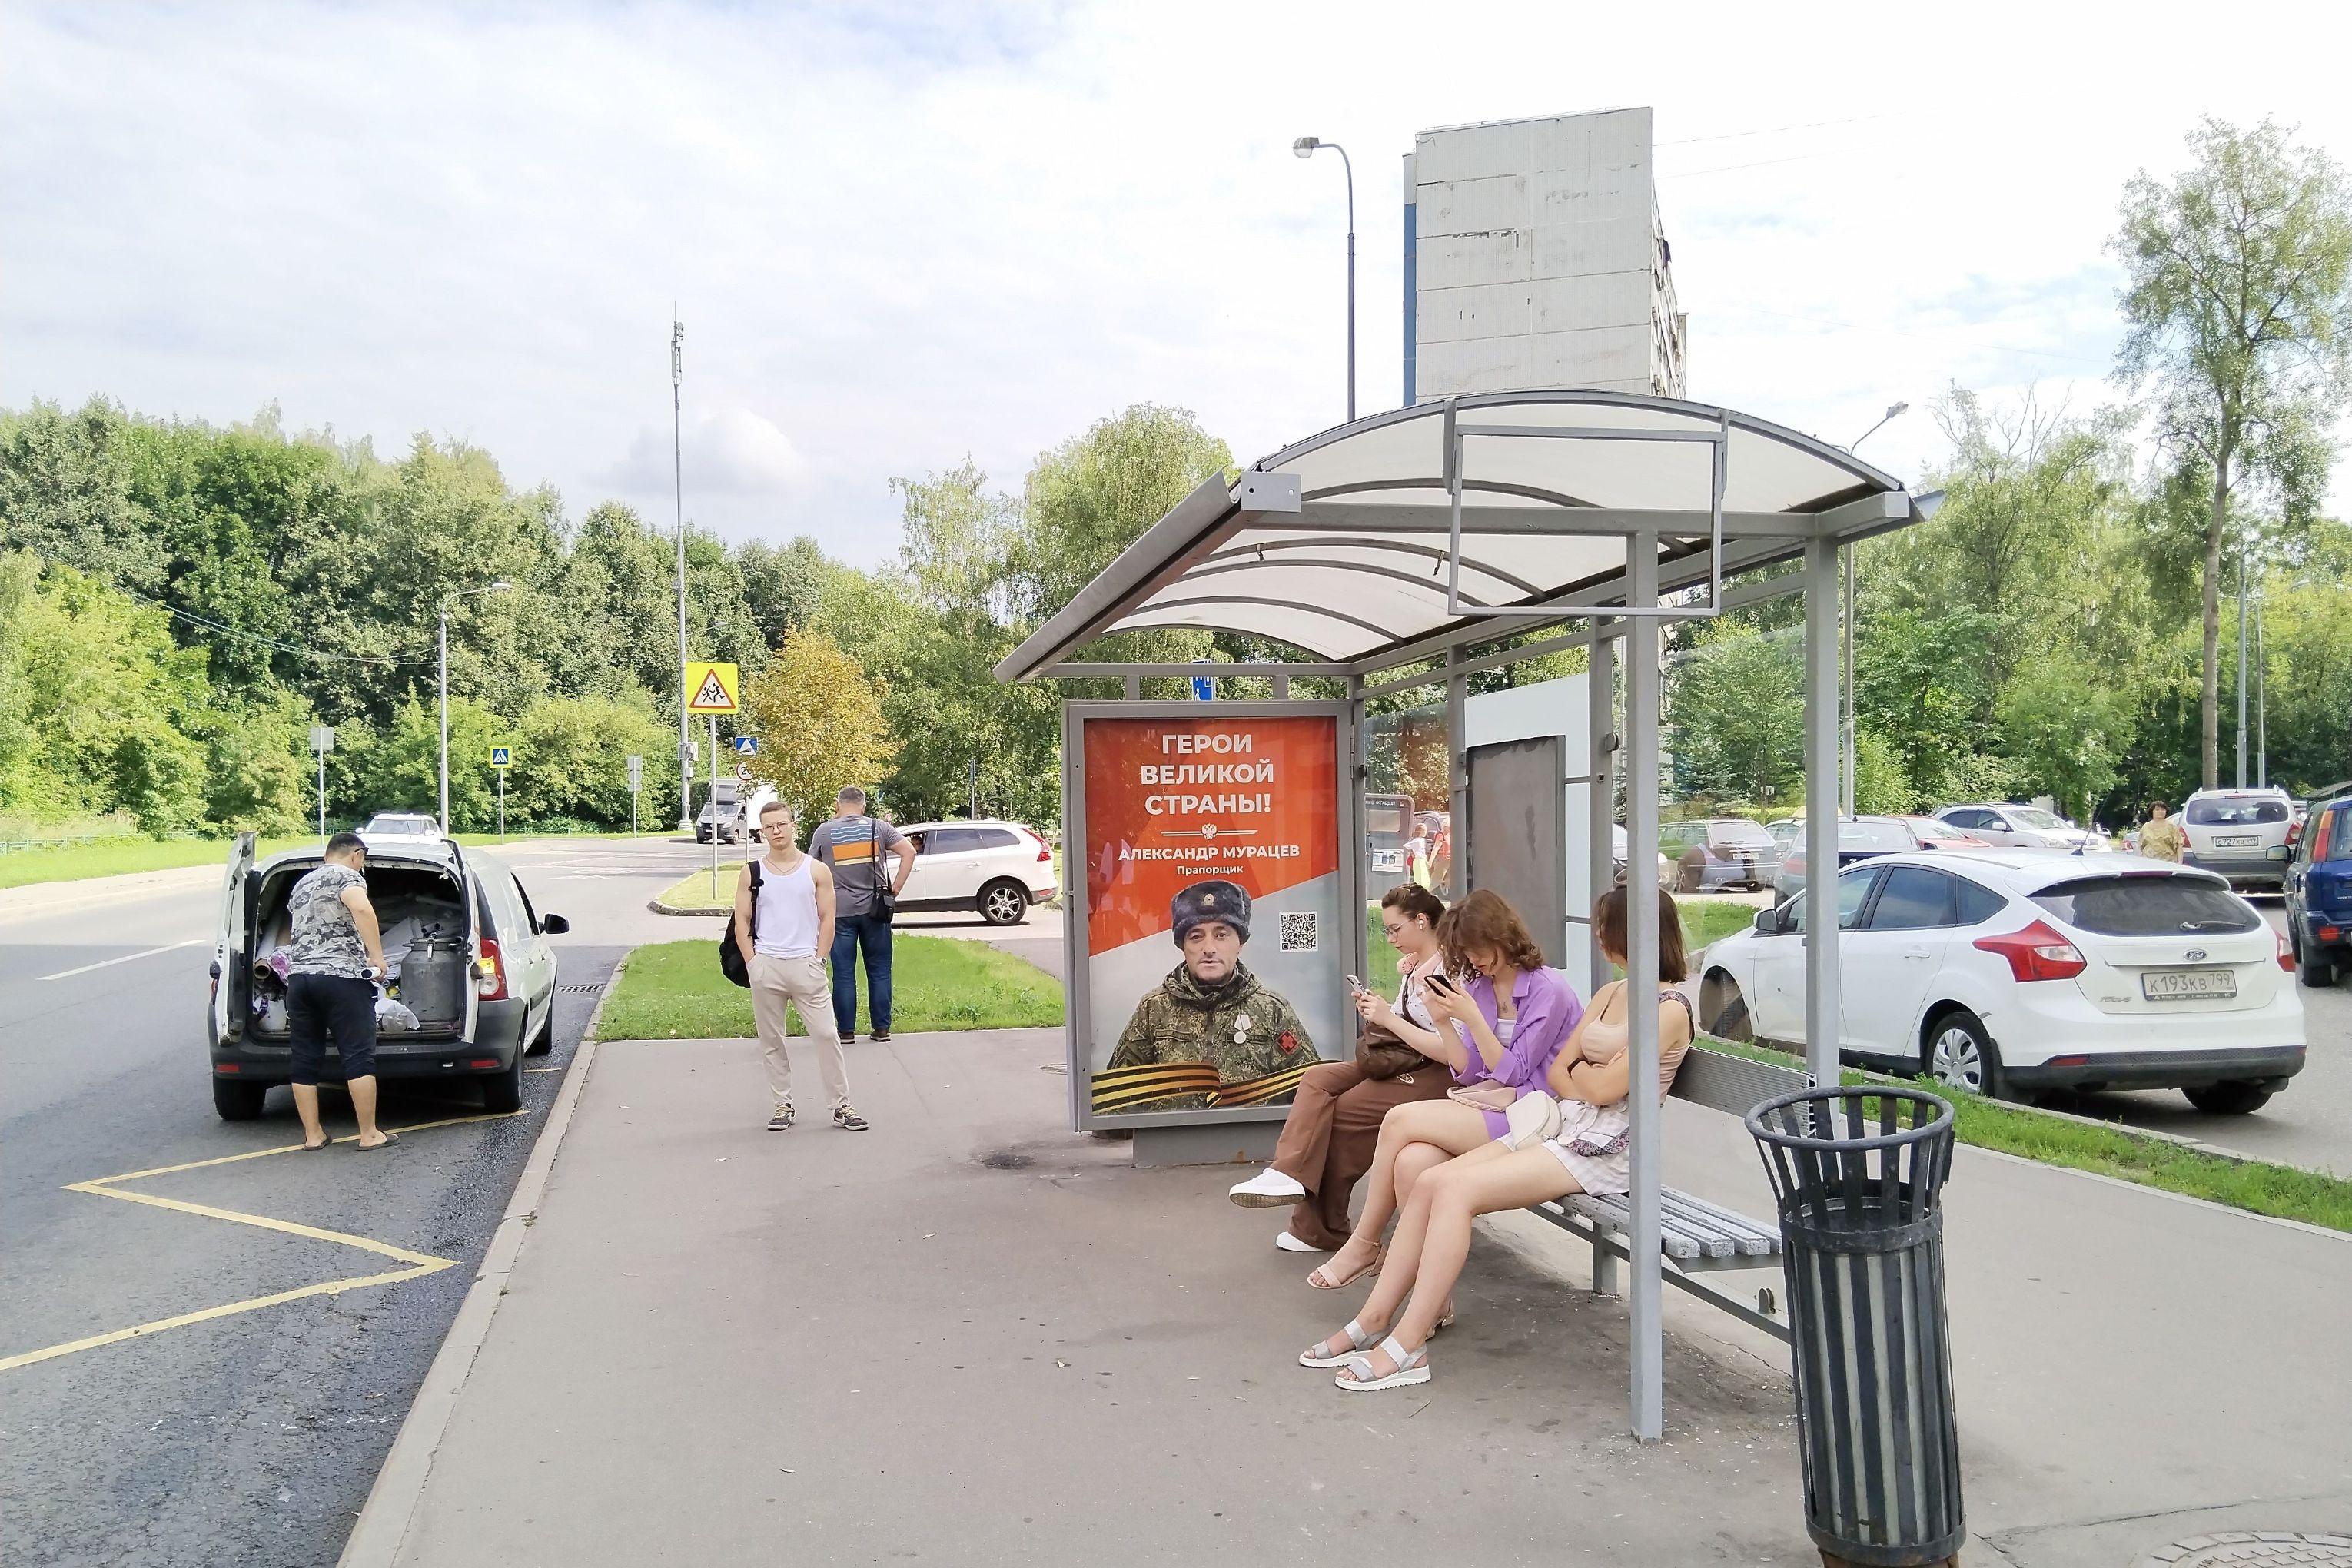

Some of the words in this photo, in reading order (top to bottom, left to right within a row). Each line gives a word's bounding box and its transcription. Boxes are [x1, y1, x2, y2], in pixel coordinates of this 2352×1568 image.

[1162, 734, 1252, 754] ГЕРОИ
[1141, 758, 1274, 785] ВЕЛИКОЙ
[1144, 793, 1271, 816] СТРАНЫ!
[1118, 846, 1219, 861] АЛЕКСАНДР
[1223, 845, 1301, 859] МУРАЦЕВ
[1177, 865, 1244, 875] Прапорщик
